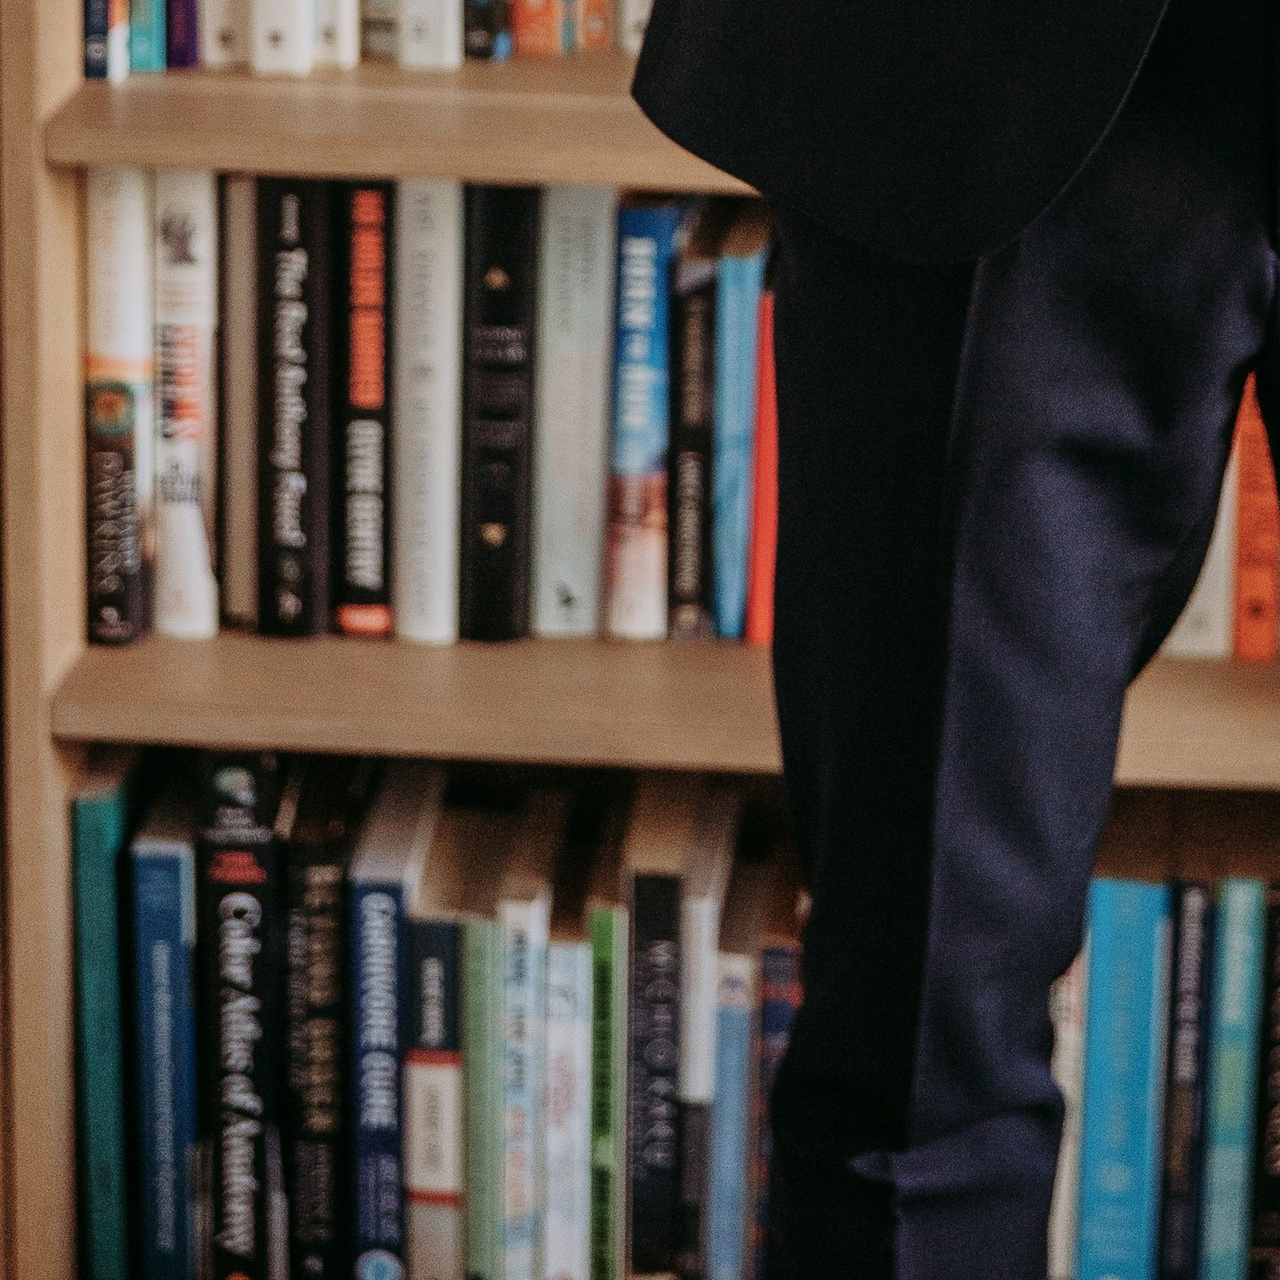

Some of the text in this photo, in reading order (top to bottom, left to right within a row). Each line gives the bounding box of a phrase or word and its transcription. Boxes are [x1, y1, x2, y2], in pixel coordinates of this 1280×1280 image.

[360, 893, 398, 1048] CARNIVORE
[215, 892, 263, 1257] Color Atlas of Anatomy
[360, 1052, 397, 1130] CURE
